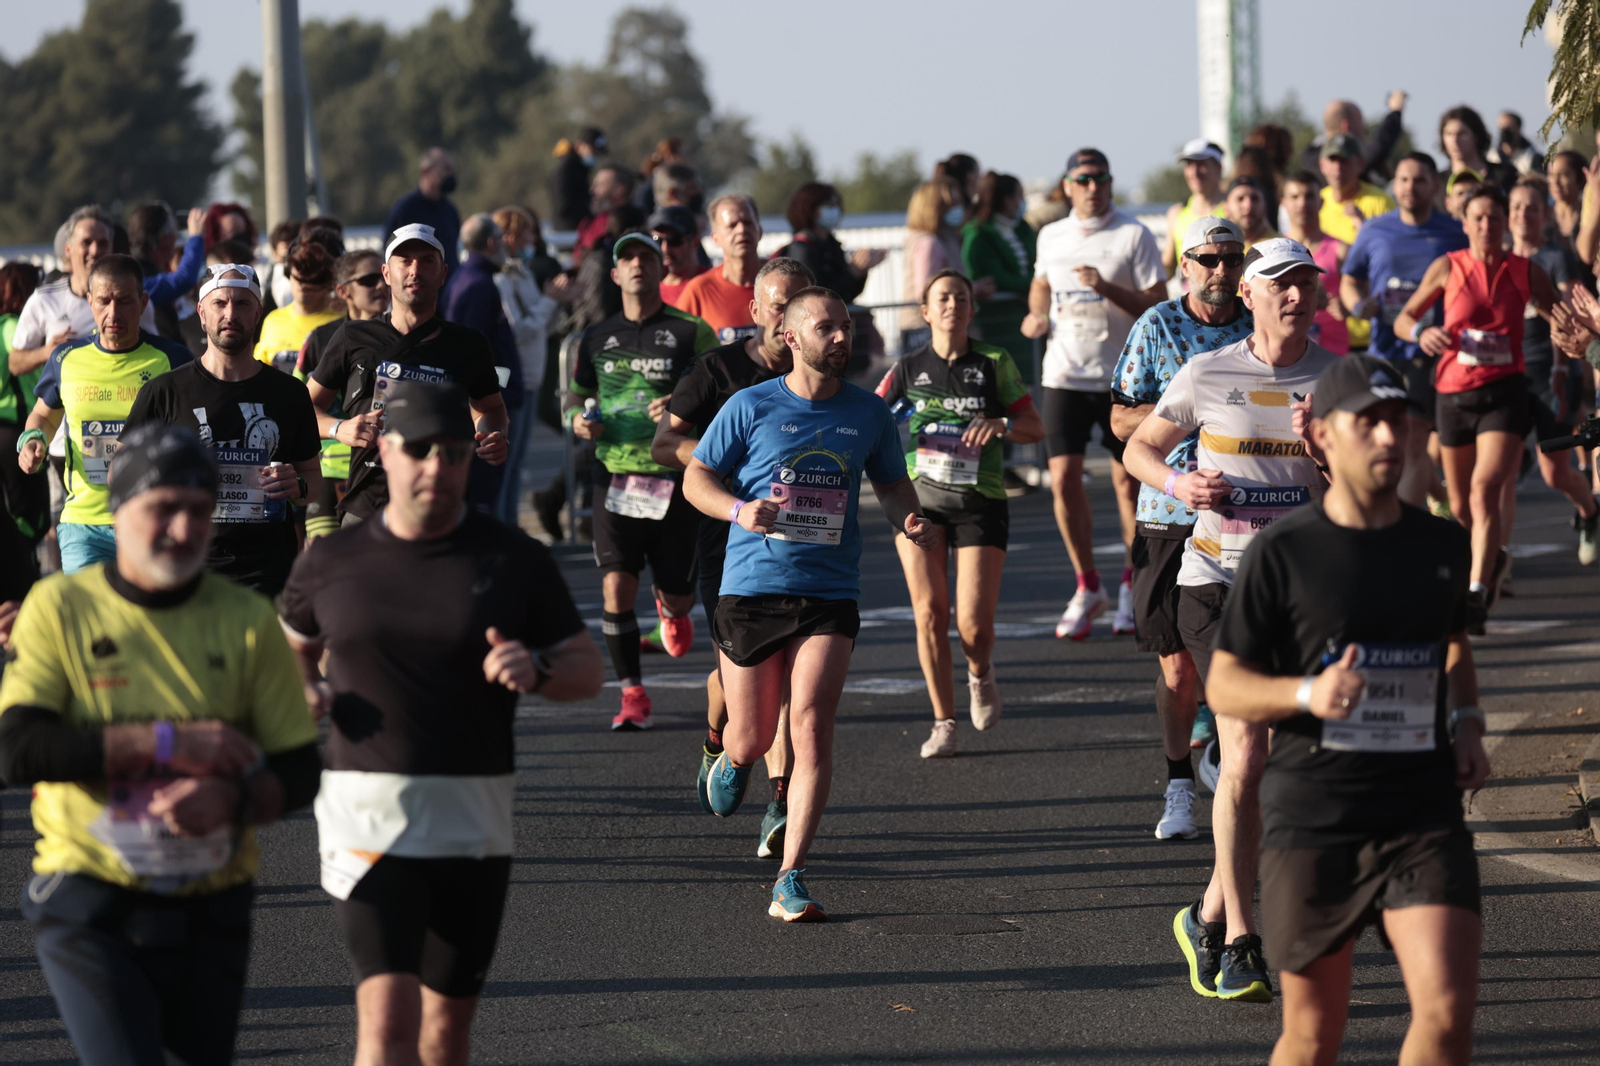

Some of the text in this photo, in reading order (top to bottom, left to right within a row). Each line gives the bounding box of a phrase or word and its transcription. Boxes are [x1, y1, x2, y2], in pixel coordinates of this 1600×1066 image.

[403, 370, 444, 384] ZURICH
[75, 386, 112, 402] SUPERate
[105, 424, 125, 433] ZUR
[781, 423, 798, 434] edp
[836, 427, 858, 436] HOKA
[217, 451, 259, 462] ZURICH
[217, 473, 242, 485] 9392
[798, 473, 841, 486] ZURICH
[217, 491, 248, 501] ELASCO
[1250, 491, 1300, 503] ZURICH
[795, 496, 823, 509] 6766
[786, 513, 828, 526] MENESES
[1368, 648, 1431, 666] ZURICH
